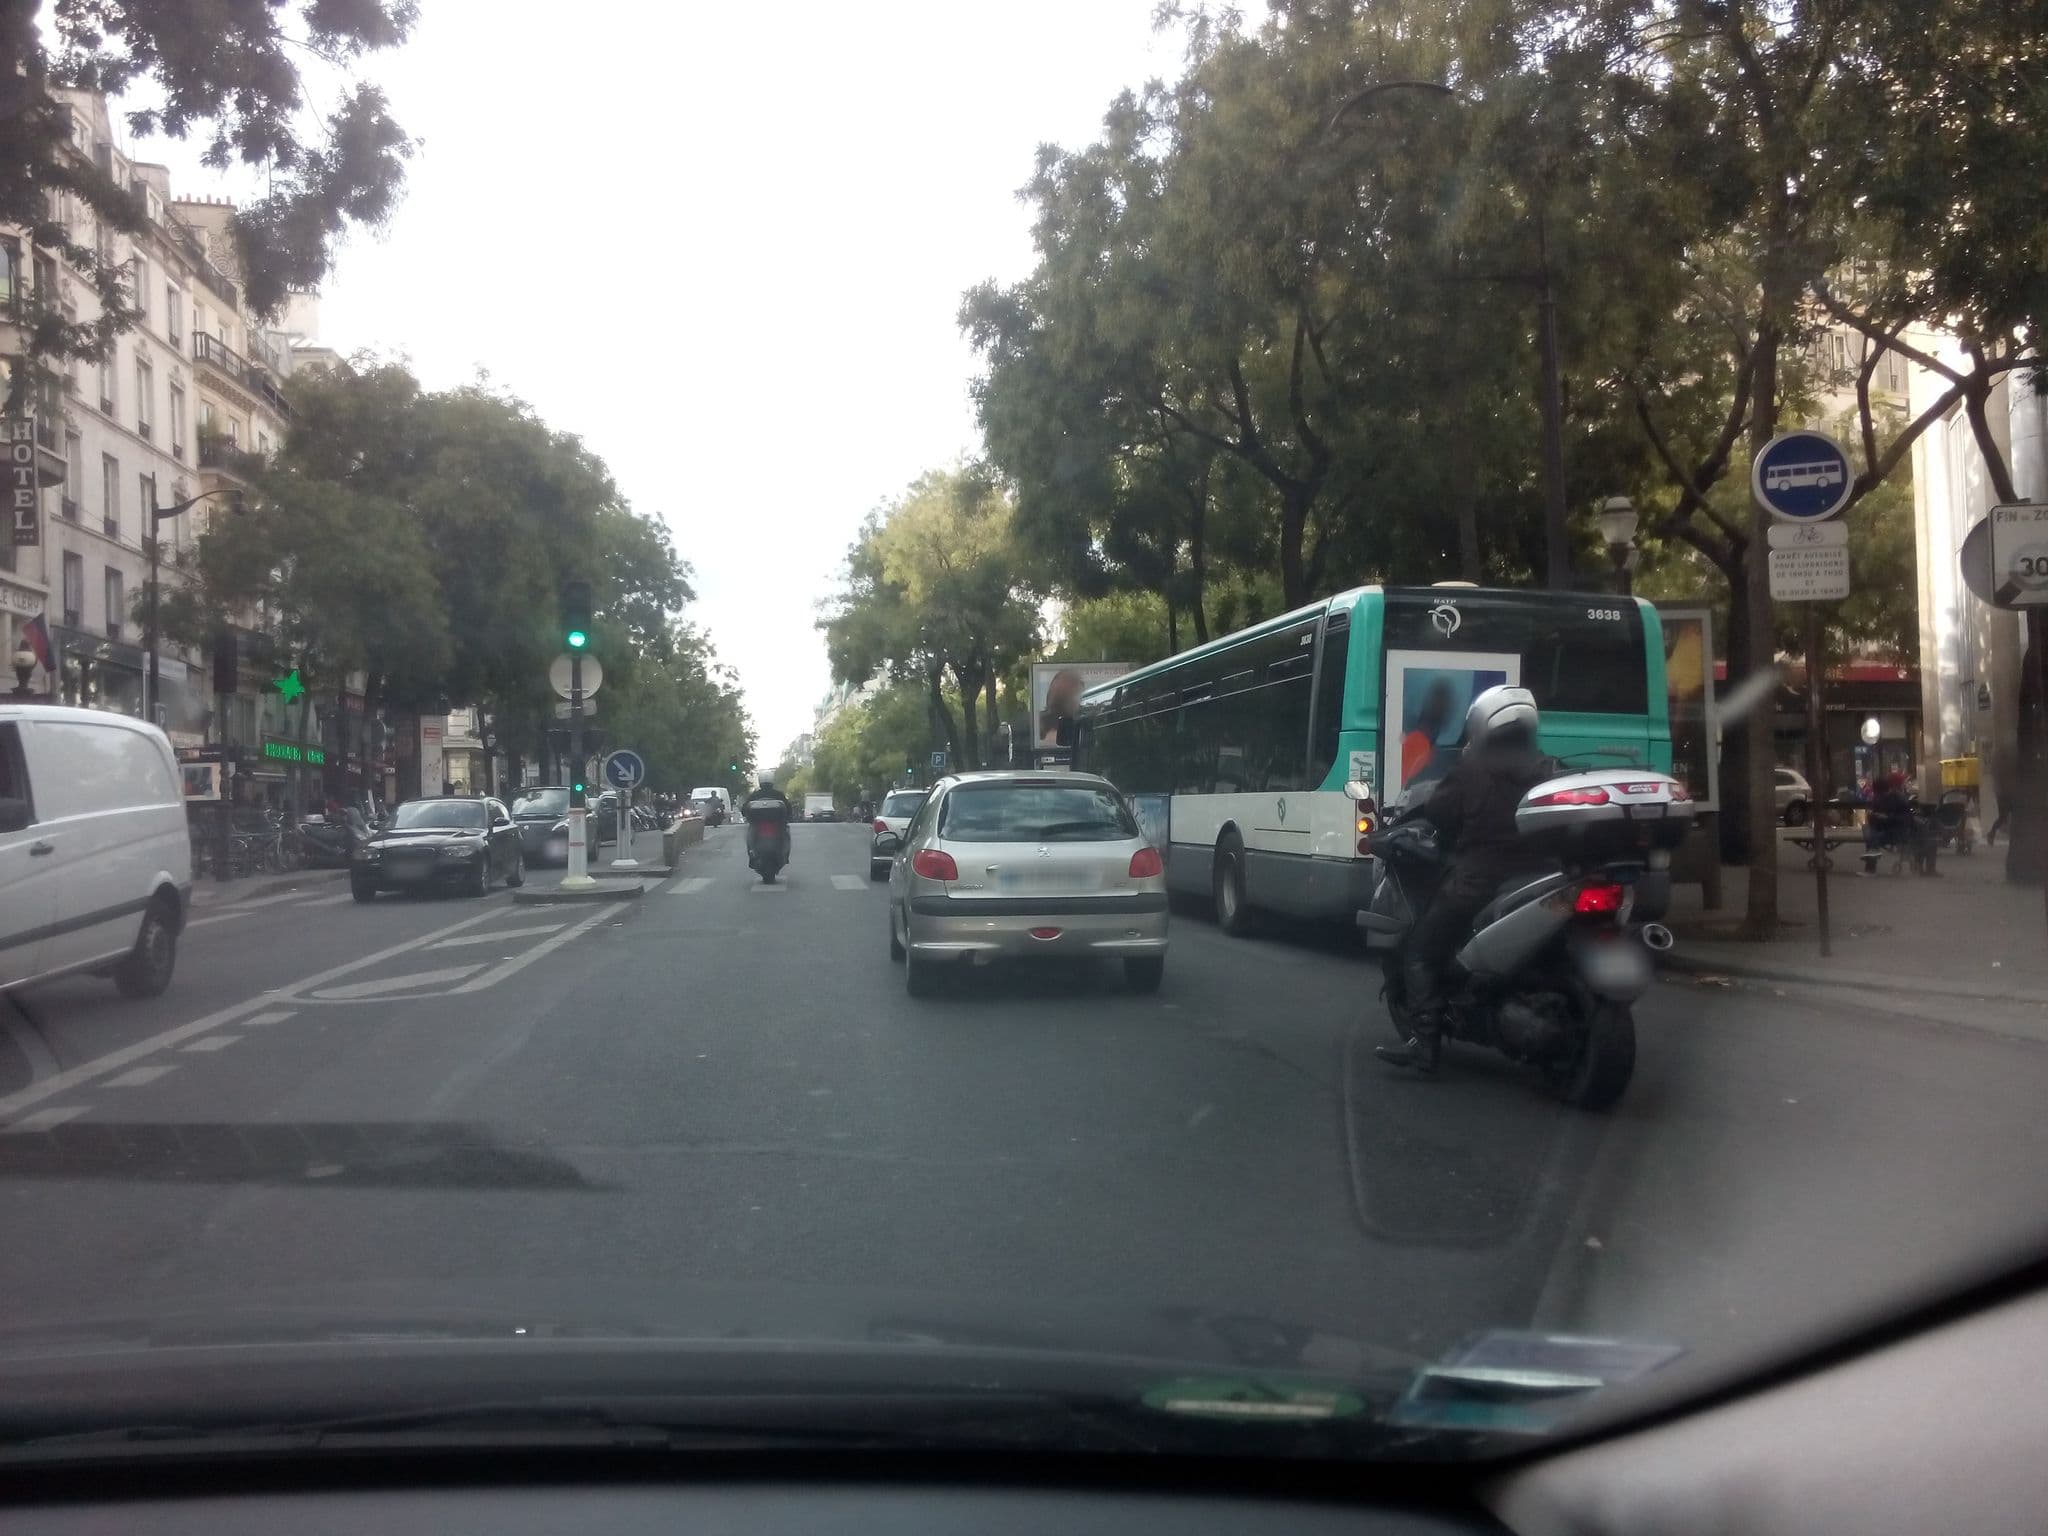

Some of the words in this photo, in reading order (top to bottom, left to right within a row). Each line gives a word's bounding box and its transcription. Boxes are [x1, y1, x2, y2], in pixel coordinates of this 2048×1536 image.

[13, 421, 34, 529] HOTEL
[1997, 510, 2017, 522] FIN
[2020, 556, 2048, 577] 30
[1586, 608, 1622, 621] 3638
